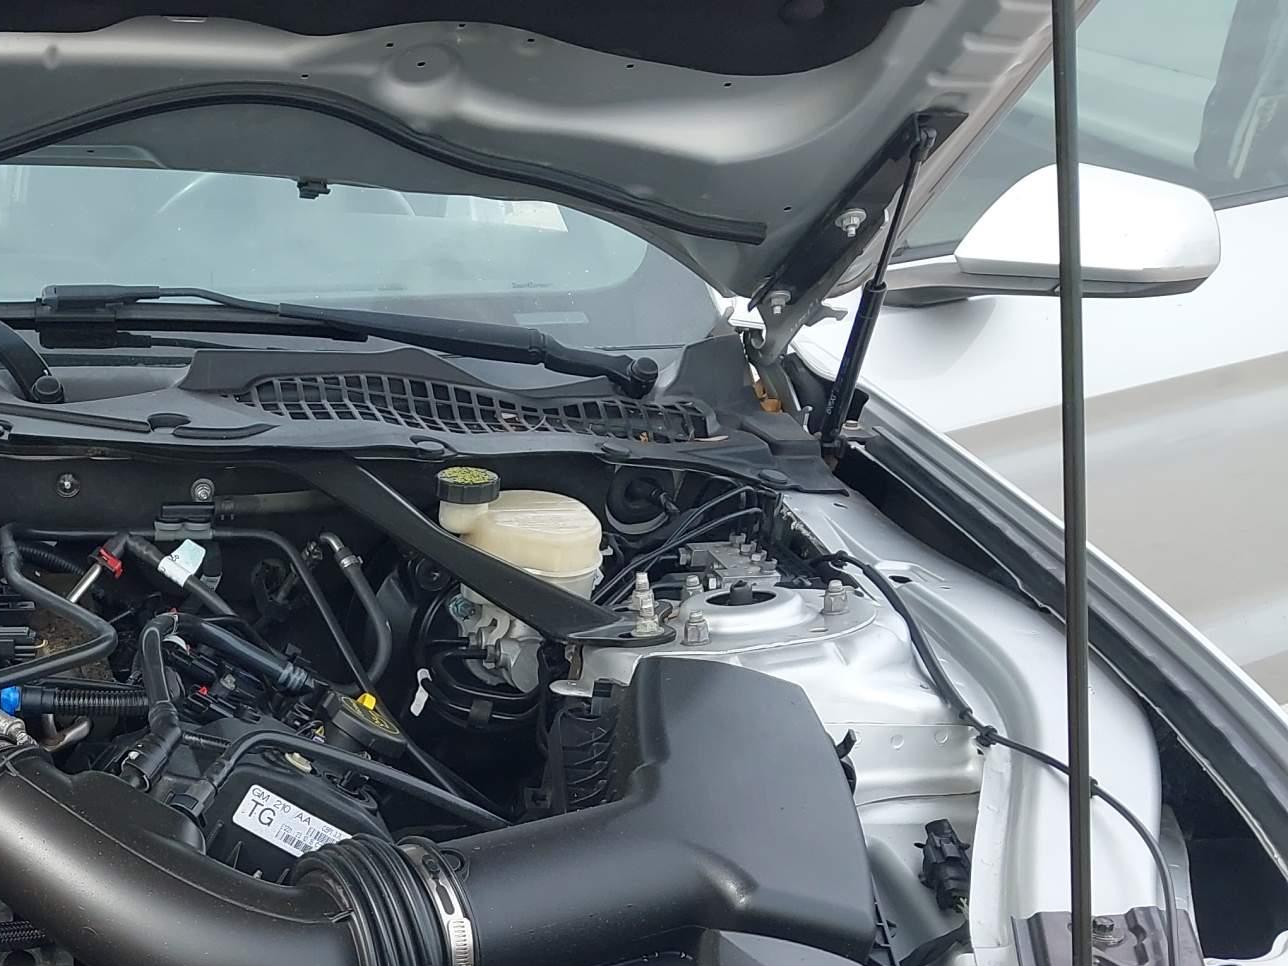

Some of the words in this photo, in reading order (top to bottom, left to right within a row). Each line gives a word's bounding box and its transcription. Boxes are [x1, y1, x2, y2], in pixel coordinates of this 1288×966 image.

[248, 799, 276, 827] TG
[252, 787, 271, 802] GM
[295, 811, 312, 826] AA
